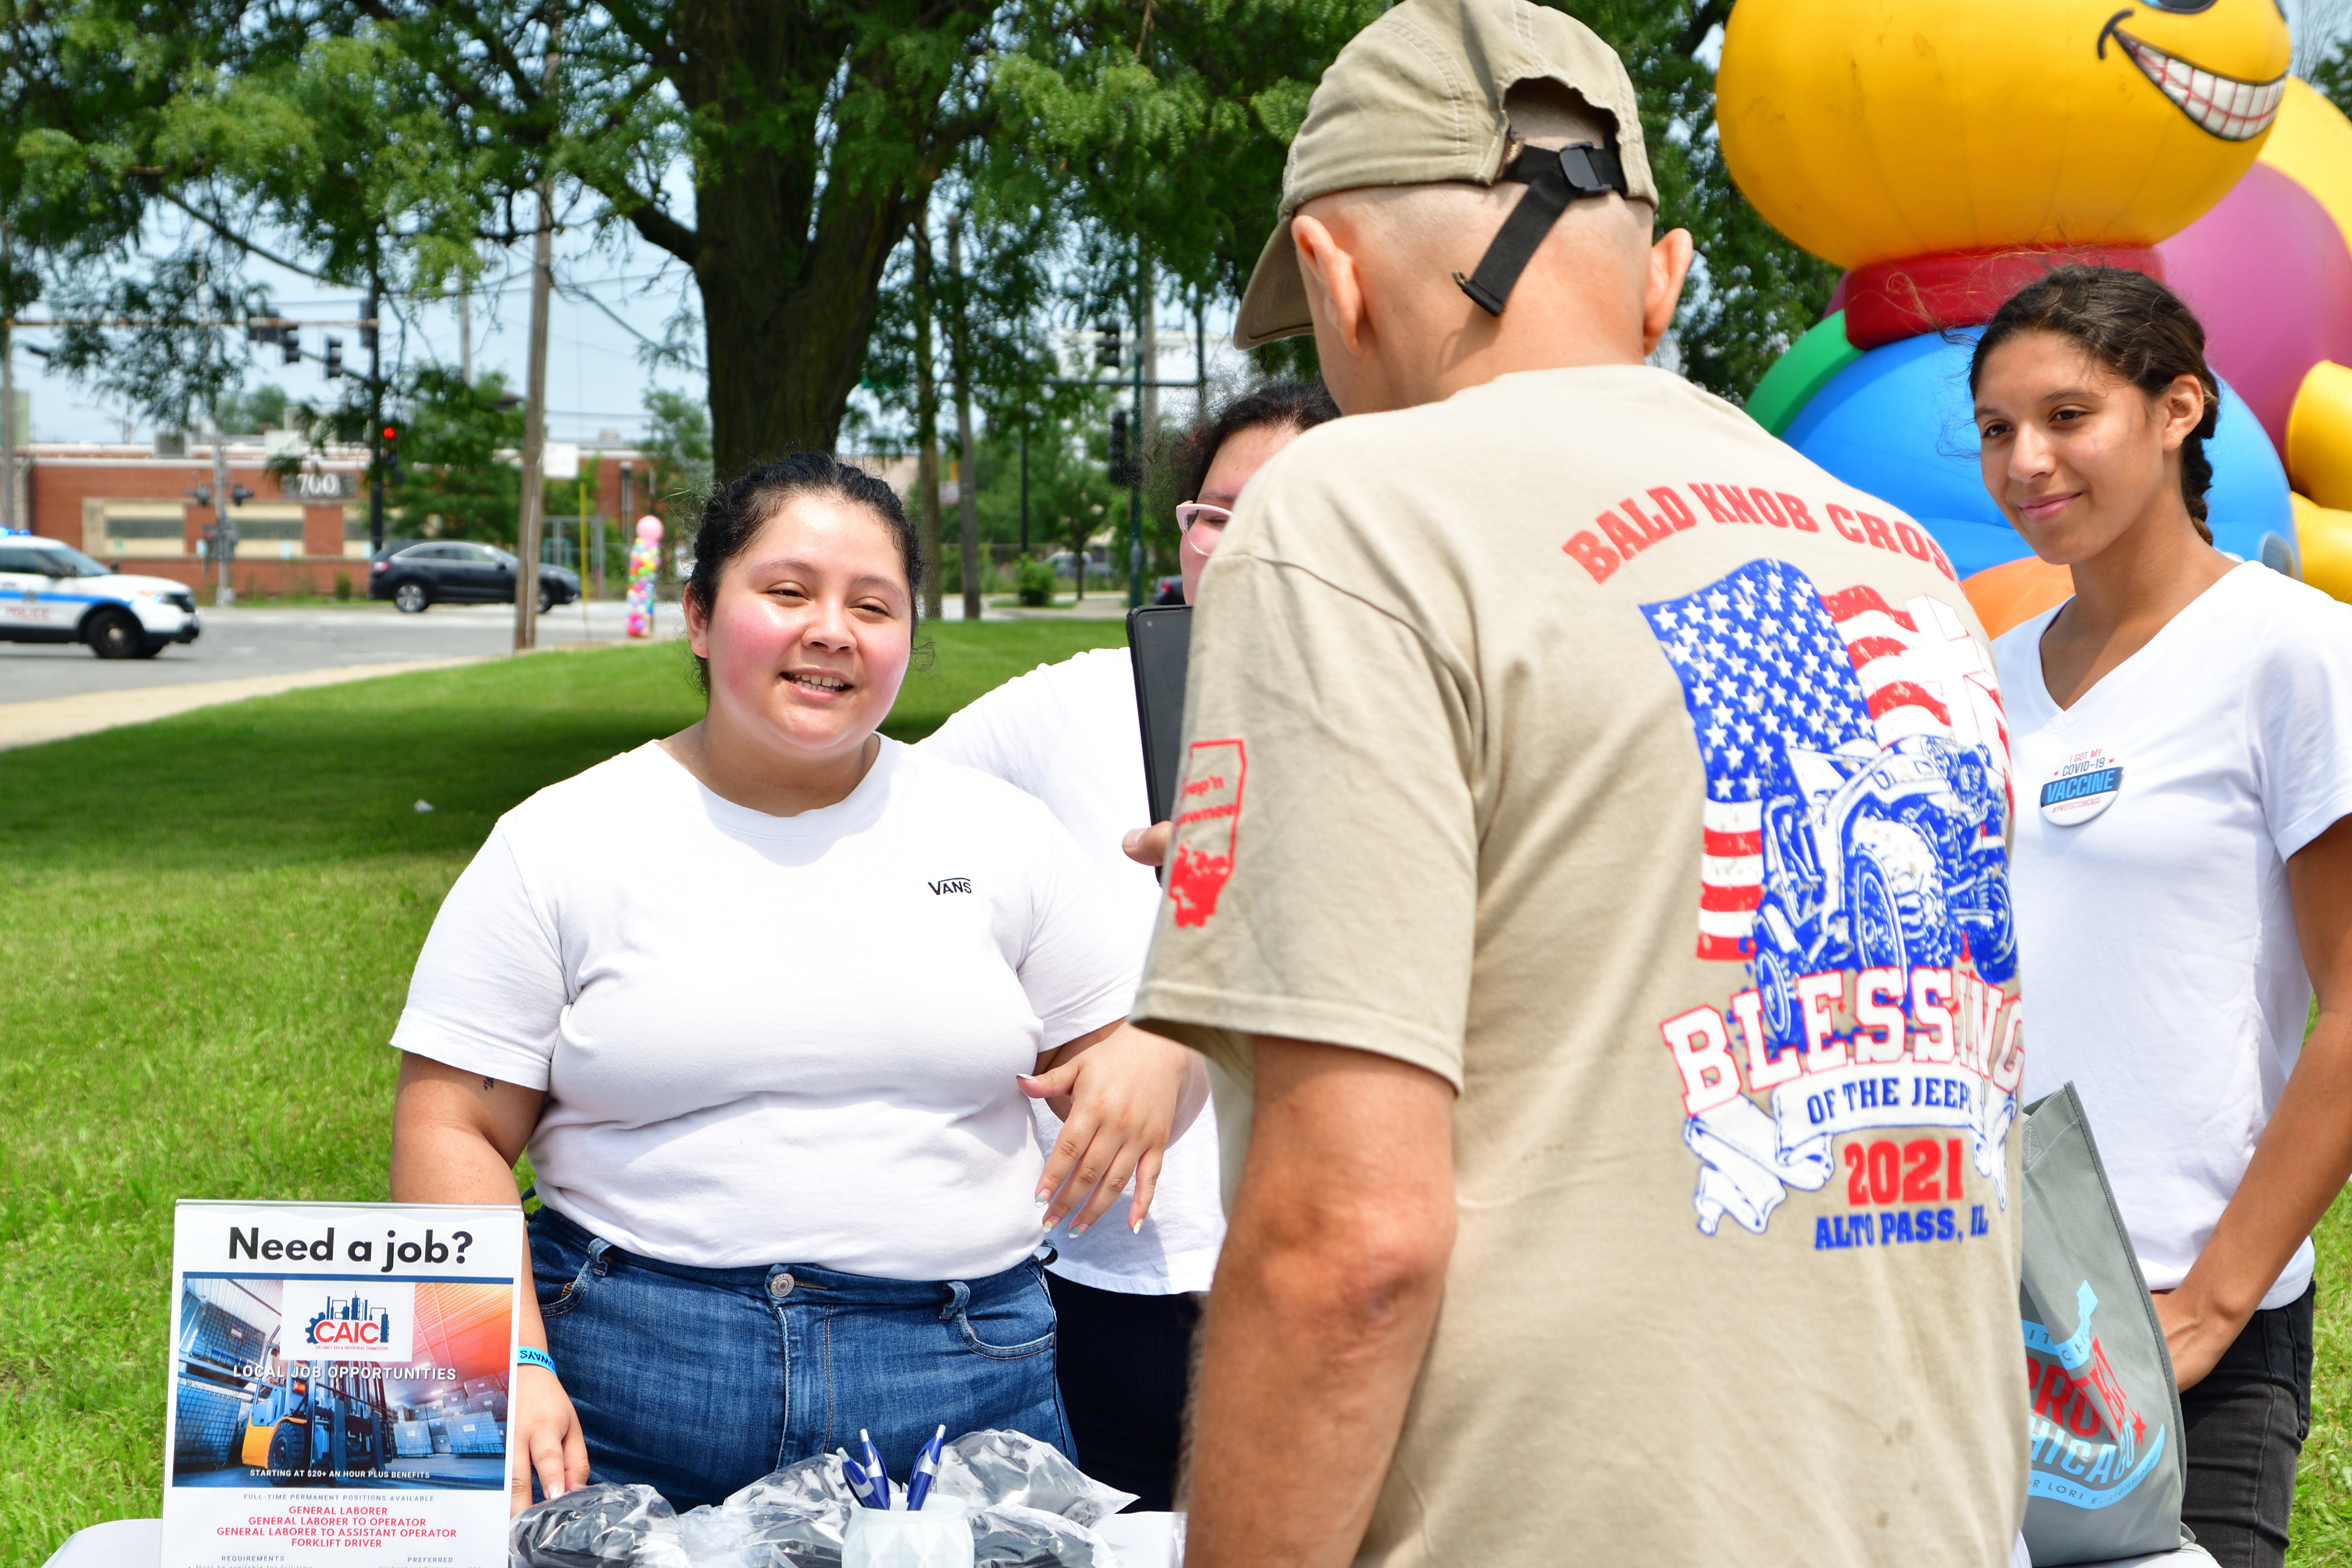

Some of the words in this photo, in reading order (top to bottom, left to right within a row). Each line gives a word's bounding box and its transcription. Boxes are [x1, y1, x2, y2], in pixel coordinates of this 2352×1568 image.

[1561, 485, 1698, 584] BALD
[1687, 482, 1820, 533] KNOB
[1825, 504, 1966, 602] CROS
[5, 606, 49, 618] POLICE
[2074, 751, 2088, 762] GOT
[2090, 748, 2103, 758] MY
[2062, 757, 2106, 776] COVID-19
[2047, 770, 2115, 803] VACCINE
[2052, 797, 2101, 814] #PROTECTCHICAGO
[928, 877, 972, 895] VANS
[1660, 966, 2025, 1117] BLESSING
[1807, 1089, 1836, 1124] OF
[1846, 1077, 1900, 1110] THE
[1843, 1139, 1964, 1207] 2021
[1815, 1215, 1874, 1250] ALTO
[1881, 1209, 1963, 1245] PASS,
[1971, 1205, 1989, 1236] IL
[229, 1227, 335, 1261] Need
[348, 1241, 372, 1262] a
[381, 1229, 473, 1273] job?
[315, 1321, 379, 1344] CAIC
[233, 1365, 285, 1377] LOCAL
[291, 1366, 321, 1379] JOB
[327, 1367, 456, 1380] OPPORTUNITIES
[2031, 1415, 2134, 1484] HICAGO
[307, 1470, 326, 1478] $20+
[2048, 1483, 2084, 1500] LORI
[289, 1506, 336, 1515] GENERAL
[340, 1507, 388, 1515] LABORER
[248, 1517, 297, 1525] GENERAL
[301, 1517, 348, 1525] LABORER
[352, 1518, 366, 1526] TO
[370, 1518, 426, 1527] OPERATOR
[217, 1527, 264, 1535] GENERAL
[269, 1527, 317, 1536] LABORER
[321, 1528, 335, 1536] TO
[338, 1528, 396, 1537] ASSISTANT
[400, 1529, 457, 1538] OPERATOR
[291, 1538, 341, 1547] FORKLIFT
[345, 1539, 382, 1548] DRIVER
